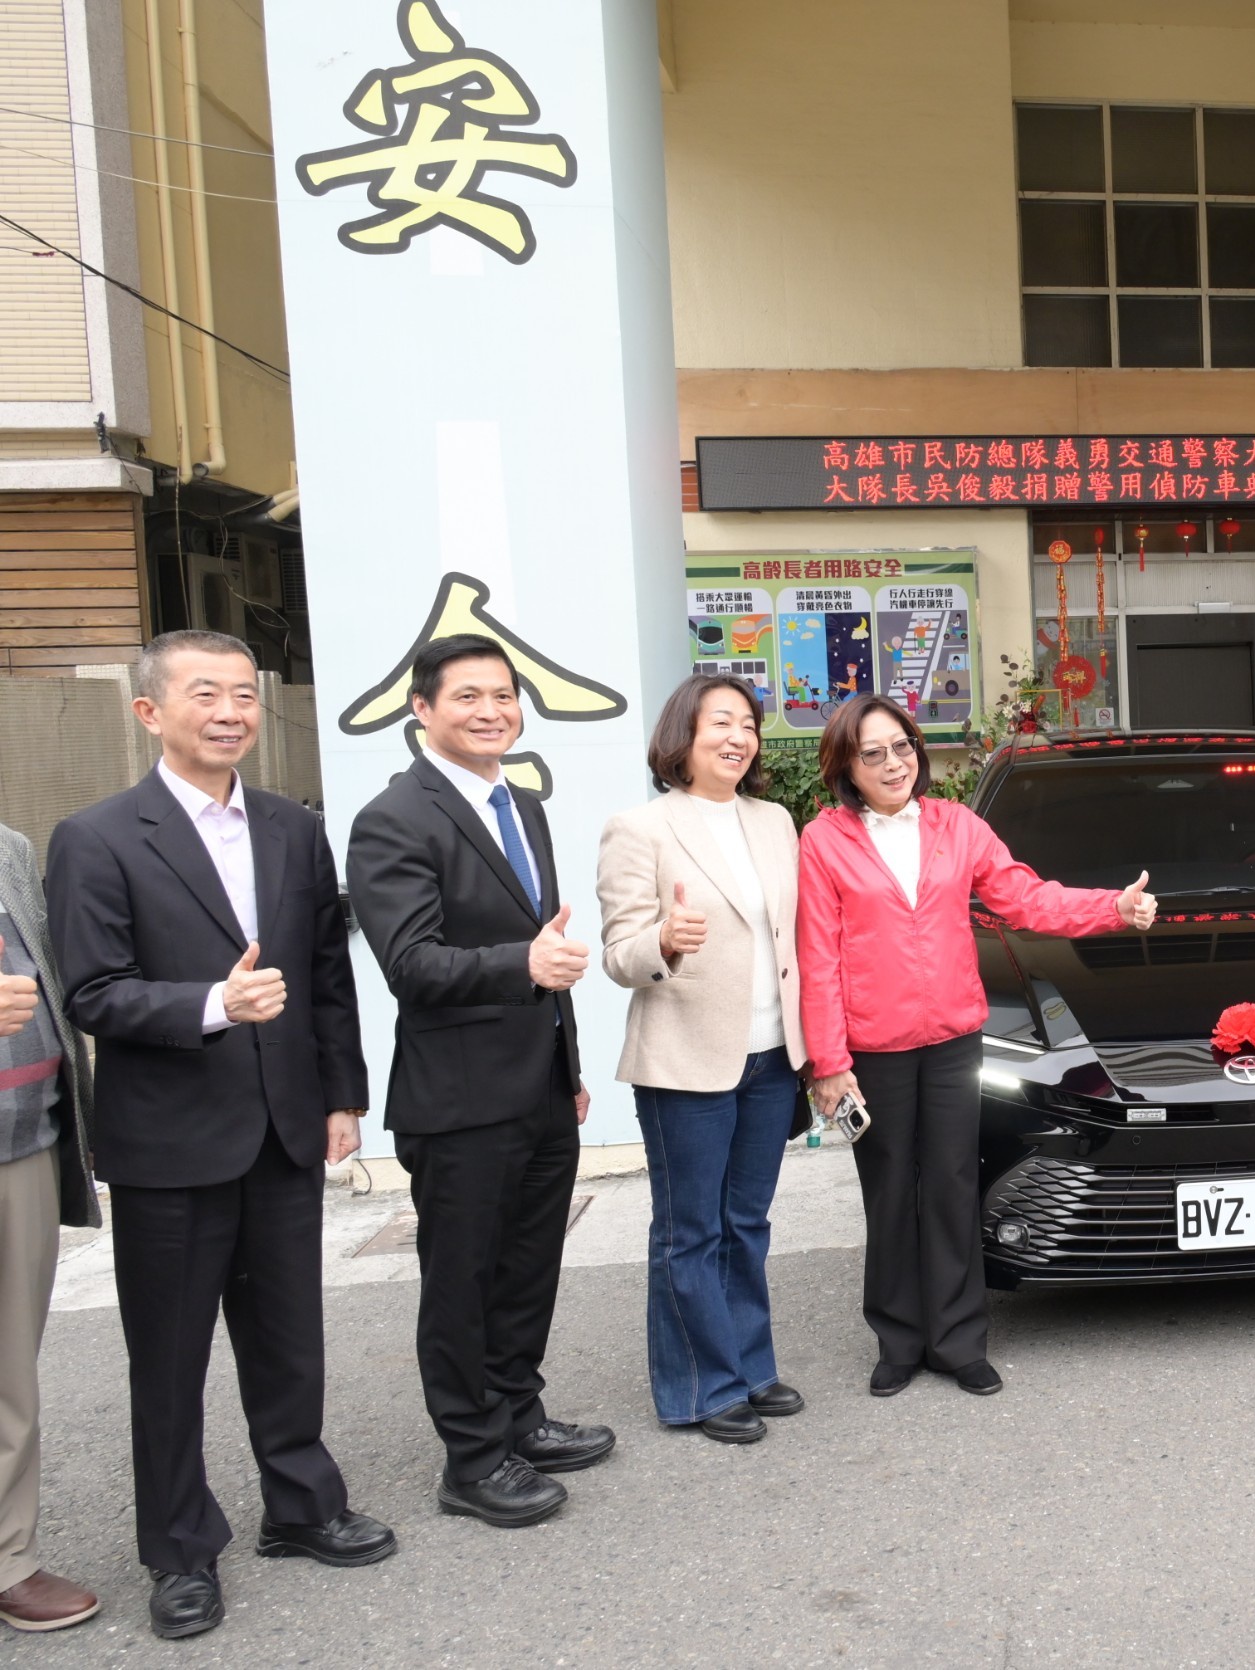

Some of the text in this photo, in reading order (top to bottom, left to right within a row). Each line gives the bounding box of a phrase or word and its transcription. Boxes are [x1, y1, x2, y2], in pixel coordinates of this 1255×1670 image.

[743, 558, 902, 580] 高齡長者用路安全
